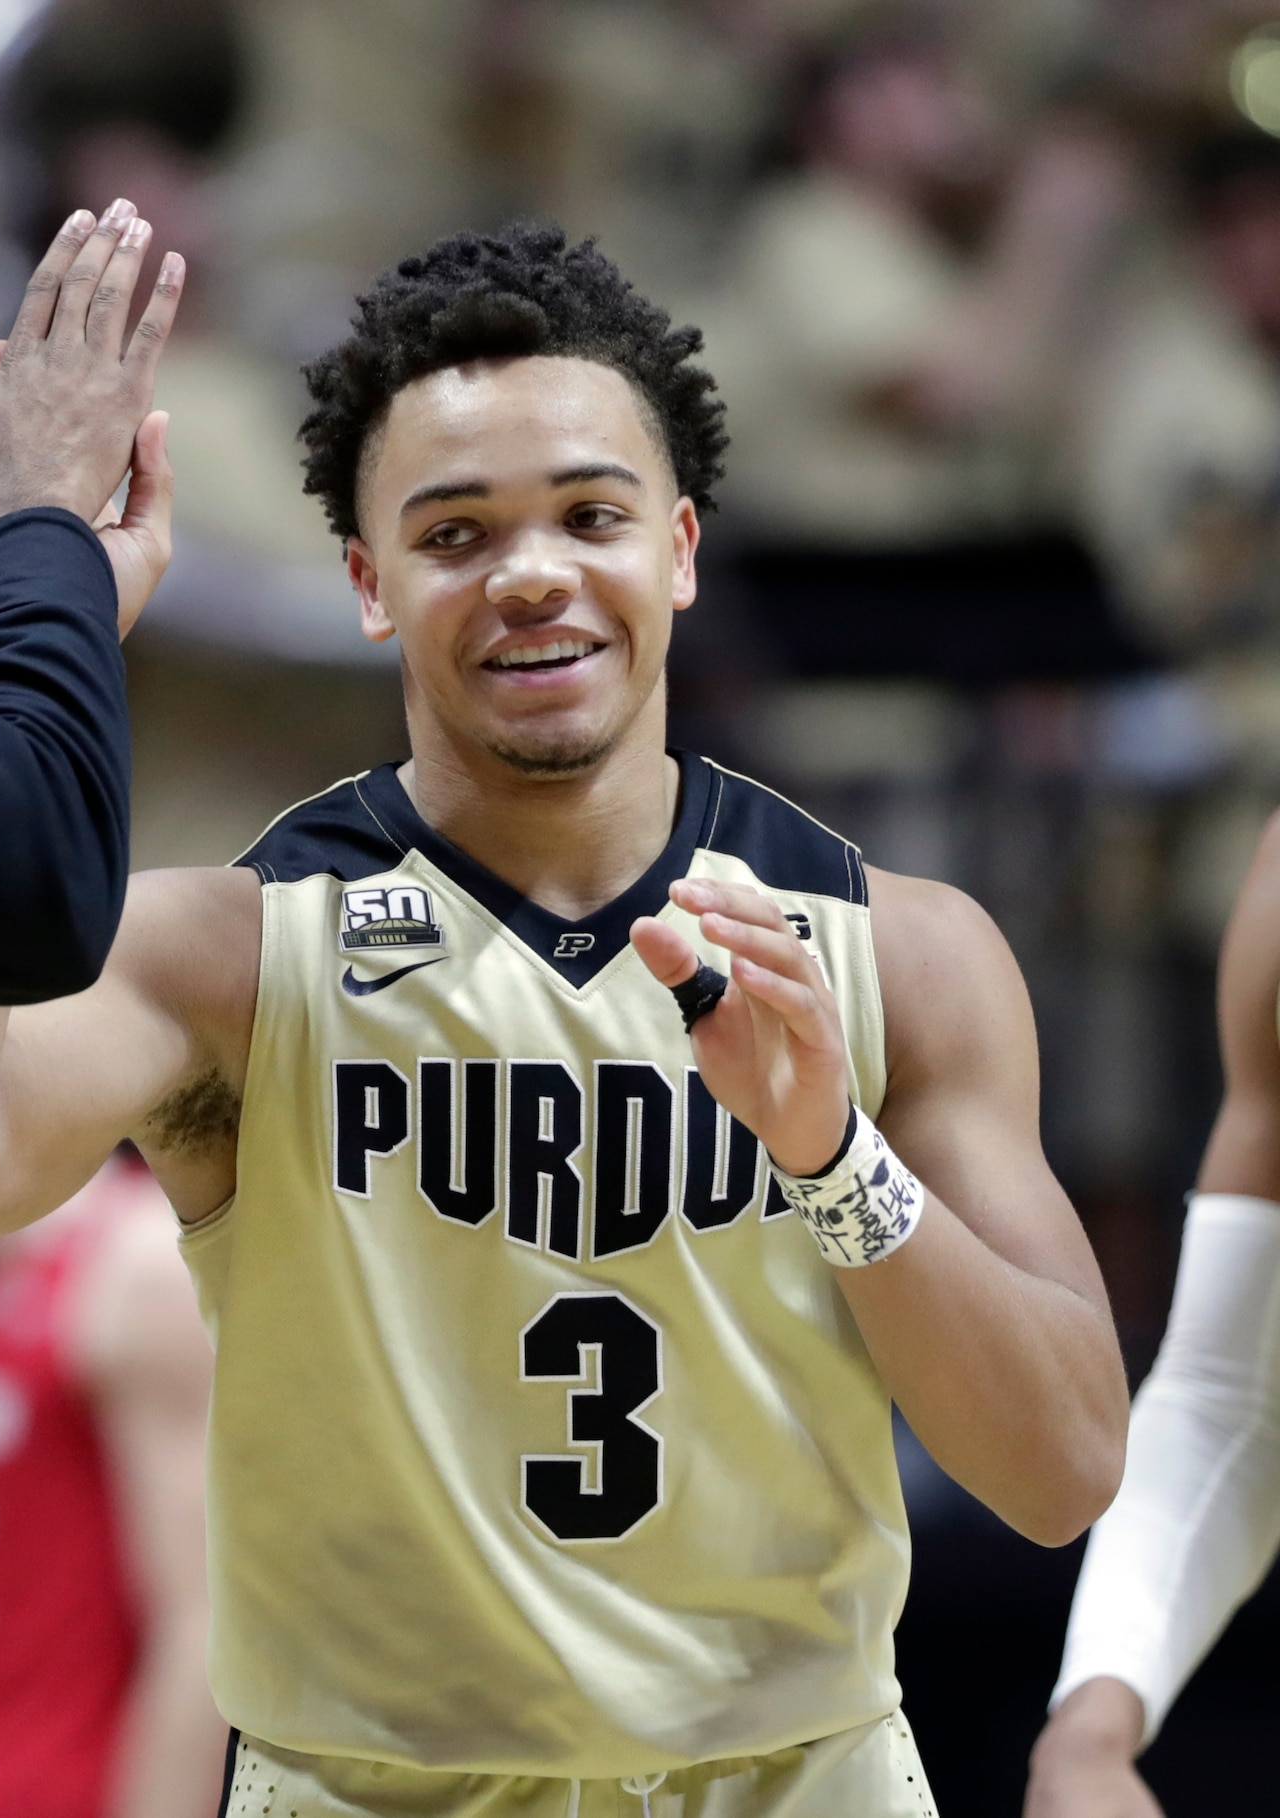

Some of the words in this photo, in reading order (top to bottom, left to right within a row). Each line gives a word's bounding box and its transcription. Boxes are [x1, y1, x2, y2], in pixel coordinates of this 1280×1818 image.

[343, 887, 433, 930] 50
[553, 933, 595, 958] P
[331, 1057, 794, 1263] PURDU
[520, 1290, 664, 1542] 3
